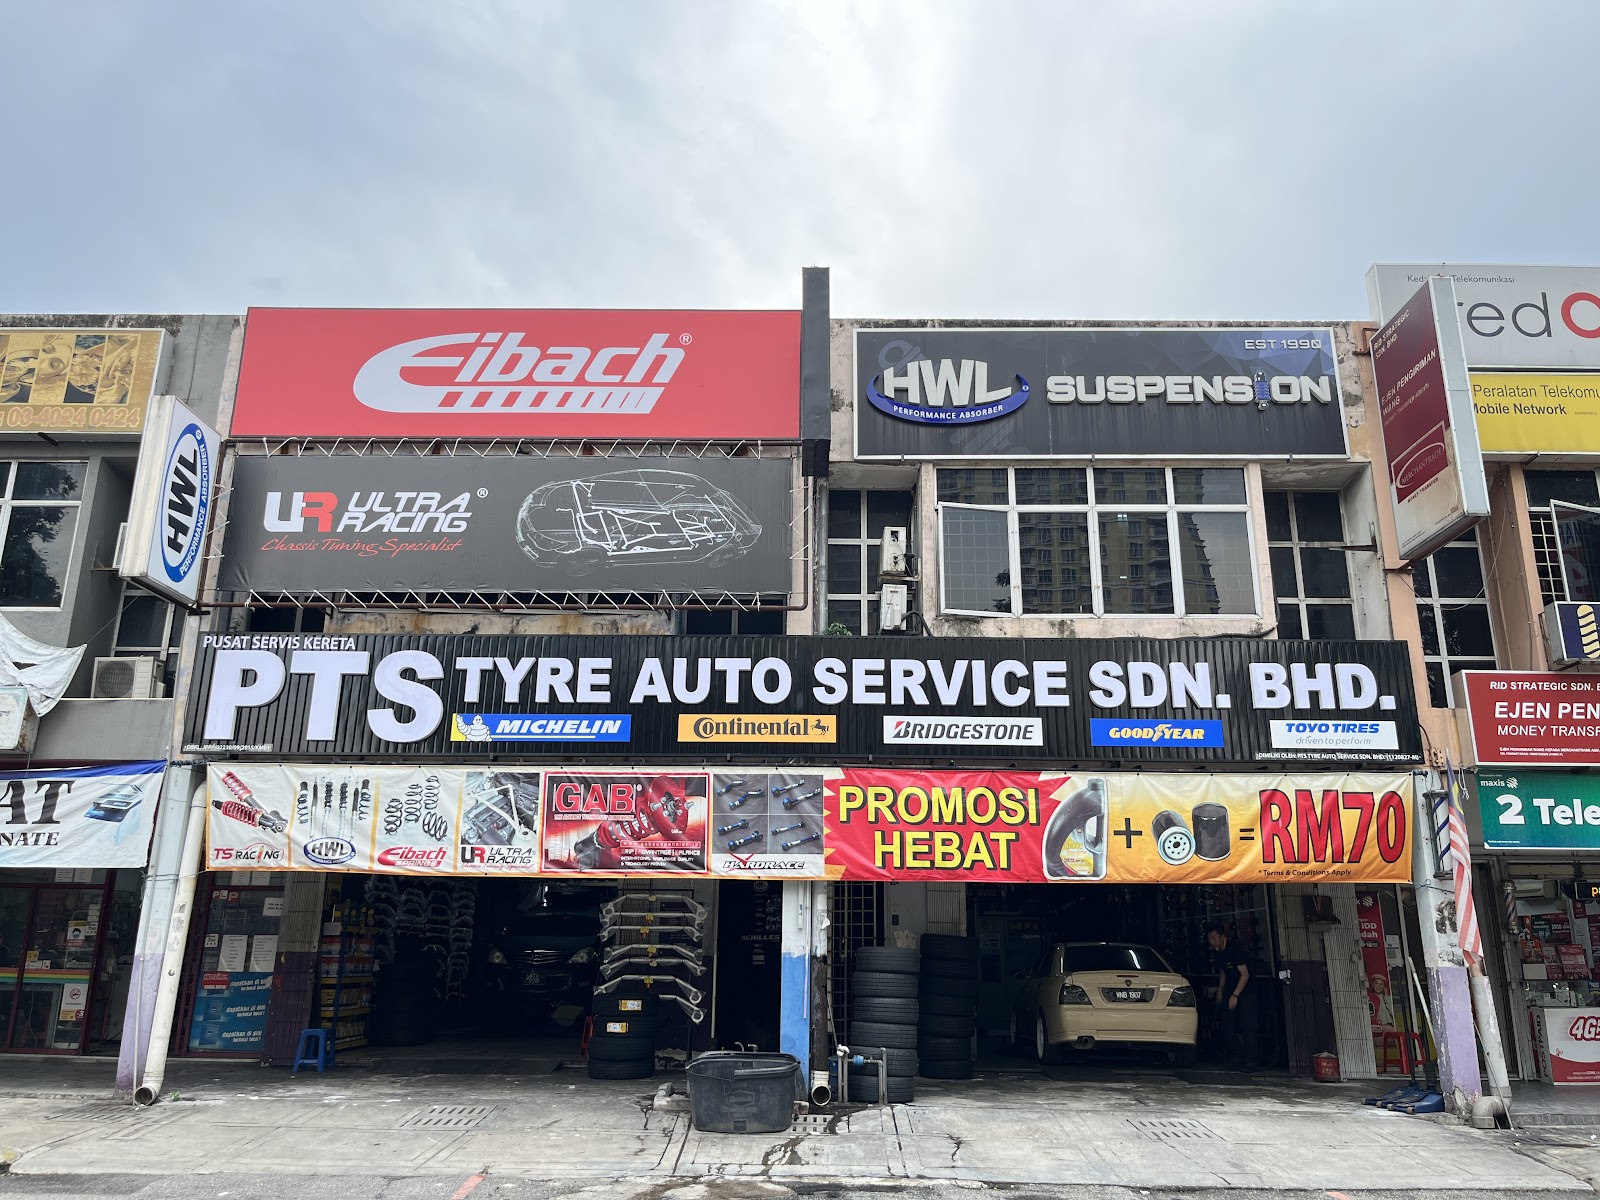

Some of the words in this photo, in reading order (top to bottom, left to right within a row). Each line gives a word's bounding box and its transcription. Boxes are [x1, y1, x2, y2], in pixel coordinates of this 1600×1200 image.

[1407, 274, 1430, 283] Ked
[1451, 274, 1515, 283] Telekomunikasi
[1456, 291, 1600, 339] edO
[1382, 310, 1410, 342] STRATEGIC
[1244, 339, 1277, 349] EST
[1280, 339, 1322, 350] 1990
[353, 331, 687, 414] Eibach
[1396, 348, 1436, 392] PENGIRIMAN
[884, 358, 1012, 407] HWL
[1046, 370, 1332, 411] SUSPENSION
[1472, 384, 1538, 398] Peralatan
[893, 405, 957, 420] PERFORMANCE
[959, 404, 1004, 419] ABSORBER
[1382, 395, 1400, 416] WANG
[1513, 402, 1568, 416] Network
[6, 407, 87, 427] 03-4024
[89, 407, 140, 428] 0424
[199, 444, 209, 503] ABSORBER
[1401, 447, 1444, 484] MERCHANTRADE
[167, 449, 198, 555] HWL
[264, 491, 338, 533] UR
[346, 491, 471, 512] ULTRA
[337, 511, 472, 533] RACING
[180, 505, 206, 577] PERFORMANCE
[260, 534, 319, 554] Chassis
[320, 535, 377, 557] Tuning
[378, 536, 463, 557] Specialist
[203, 635, 250, 649] PUSAT
[251, 635, 301, 650] SERVIS
[303, 636, 357, 651] KERETA
[204, 649, 445, 743] PTS
[455, 656, 613, 705] TYRE
[628, 656, 792, 706] AUTO
[812, 657, 1070, 708] SERVICE
[1089, 660, 1232, 711] SDN.
[1248, 661, 1397, 711] BHD.
[1489, 681, 1508, 690] RID
[1510, 681, 1568, 691] STRATEGIC
[1570, 682, 1594, 691] SDN.
[1494, 701, 1551, 719] EJEN
[1557, 702, 1600, 720] PEN
[495, 718, 623, 735] MICHELIN
[693, 716, 811, 740] Continental
[891, 719, 1035, 740] BRIDGESTONE
[1108, 725, 1206, 742] GOODYEAR
[1285, 722, 1330, 733] TOYO
[1331, 723, 1380, 734] TIRES
[1497, 724, 1547, 737] MONEY
[1295, 735, 1324, 745] driven
[1325, 737, 1335, 745] to
[1335, 736, 1372, 746] perform
[1480, 778, 1506, 787] maxis
[553, 782, 637, 813] GAB
[839, 785, 1040, 827] PROMOSI
[1495, 793, 1526, 825] 2
[1532, 798, 1600, 826] Tele
[1258, 788, 1406, 864] RM70
[213, 848, 235, 860] TS
[311, 841, 349, 857] HWL
[377, 846, 448, 868] Eibach
[461, 846, 486, 864] UR
[489, 847, 533, 856] ULTRA
[874, 830, 1022, 871] HEBAT
[486, 856, 533, 864] RACING
[722, 861, 806, 870] HARDRACE
[1330, 868, 1352, 878] Apply
[1360, 922, 1378, 930] IDD
